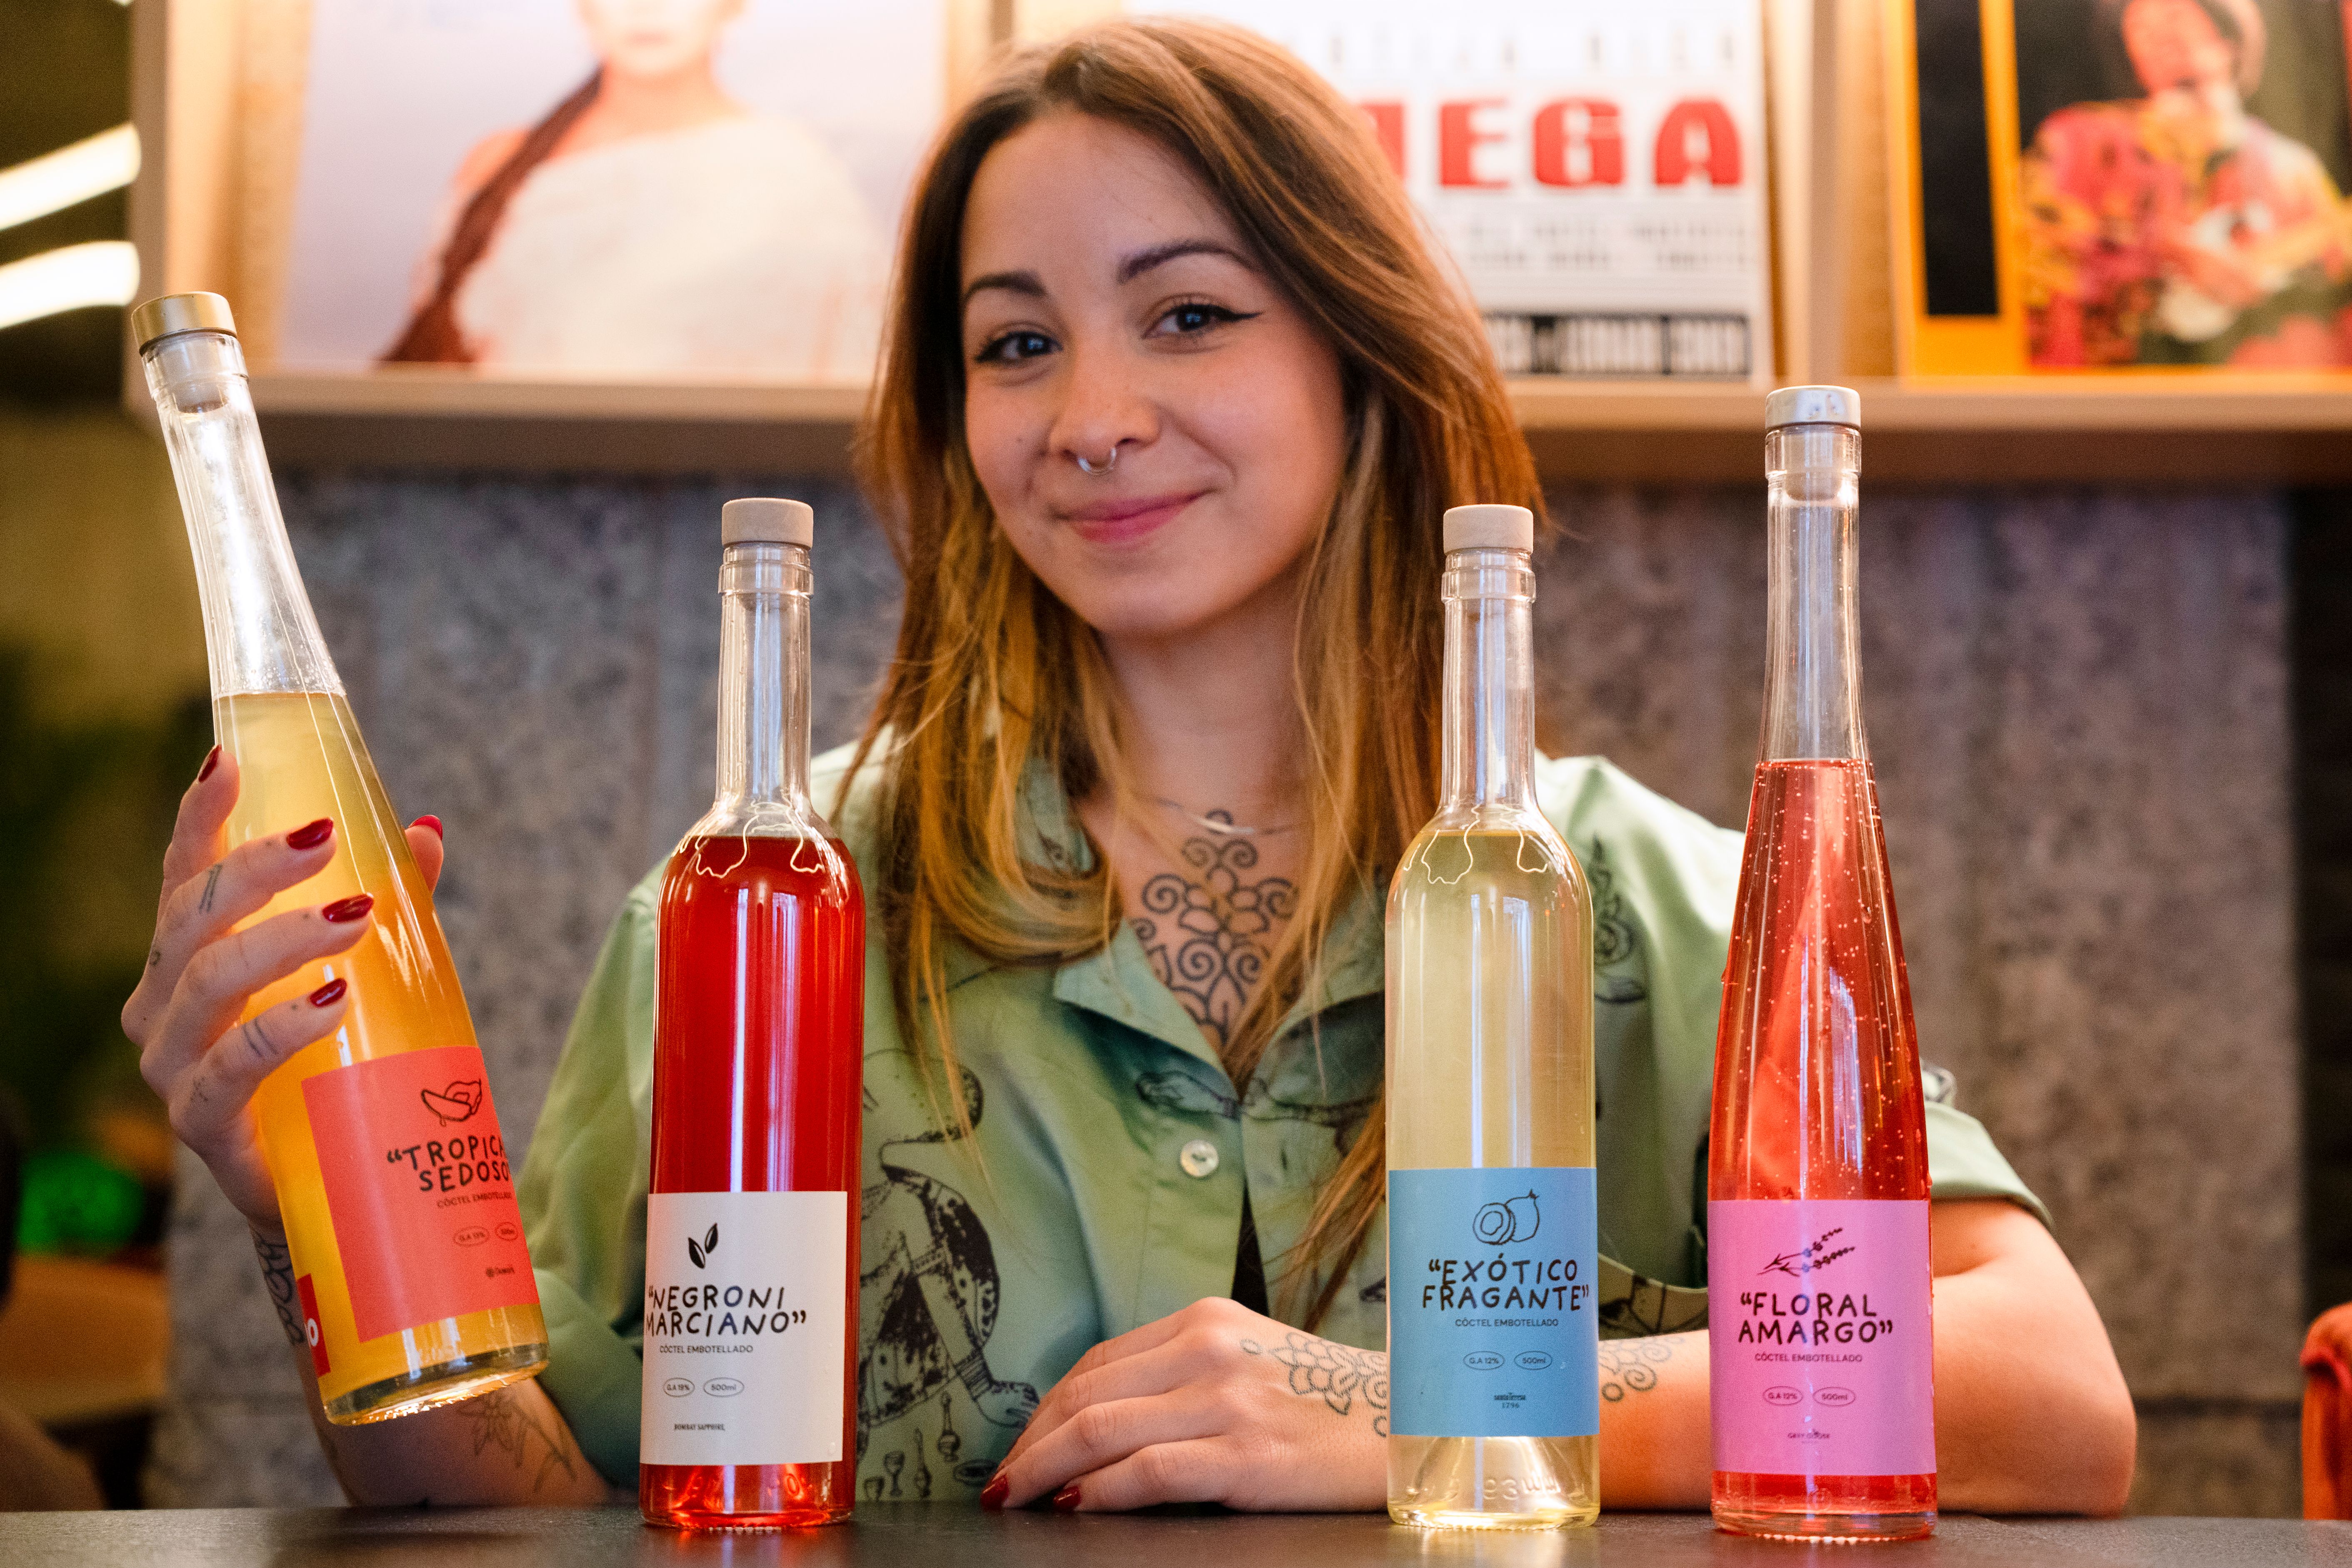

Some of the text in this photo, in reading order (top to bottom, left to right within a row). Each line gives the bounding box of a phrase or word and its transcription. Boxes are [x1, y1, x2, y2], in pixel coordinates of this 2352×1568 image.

[437, 1196, 471, 1208] CÓCTEL
[1428, 1252, 1577, 1285] “EXÓTICO
[649, 1284, 784, 1312] “NEGRONI
[1422, 1285, 1589, 1311] FRAGANTE”
[1740, 1292, 1877, 1319] “FLORAL
[646, 1309, 806, 1338] MARCIANO”
[1455, 1317, 1559, 1327] CÓCTEL EMBOTELLADO
[1738, 1319, 1893, 1346] AMARGO”
[660, 1344, 753, 1353] CÓCTEL EMBOTELLADO
[1755, 1352, 1863, 1363] CÓCTEL EMBOTELLADO
